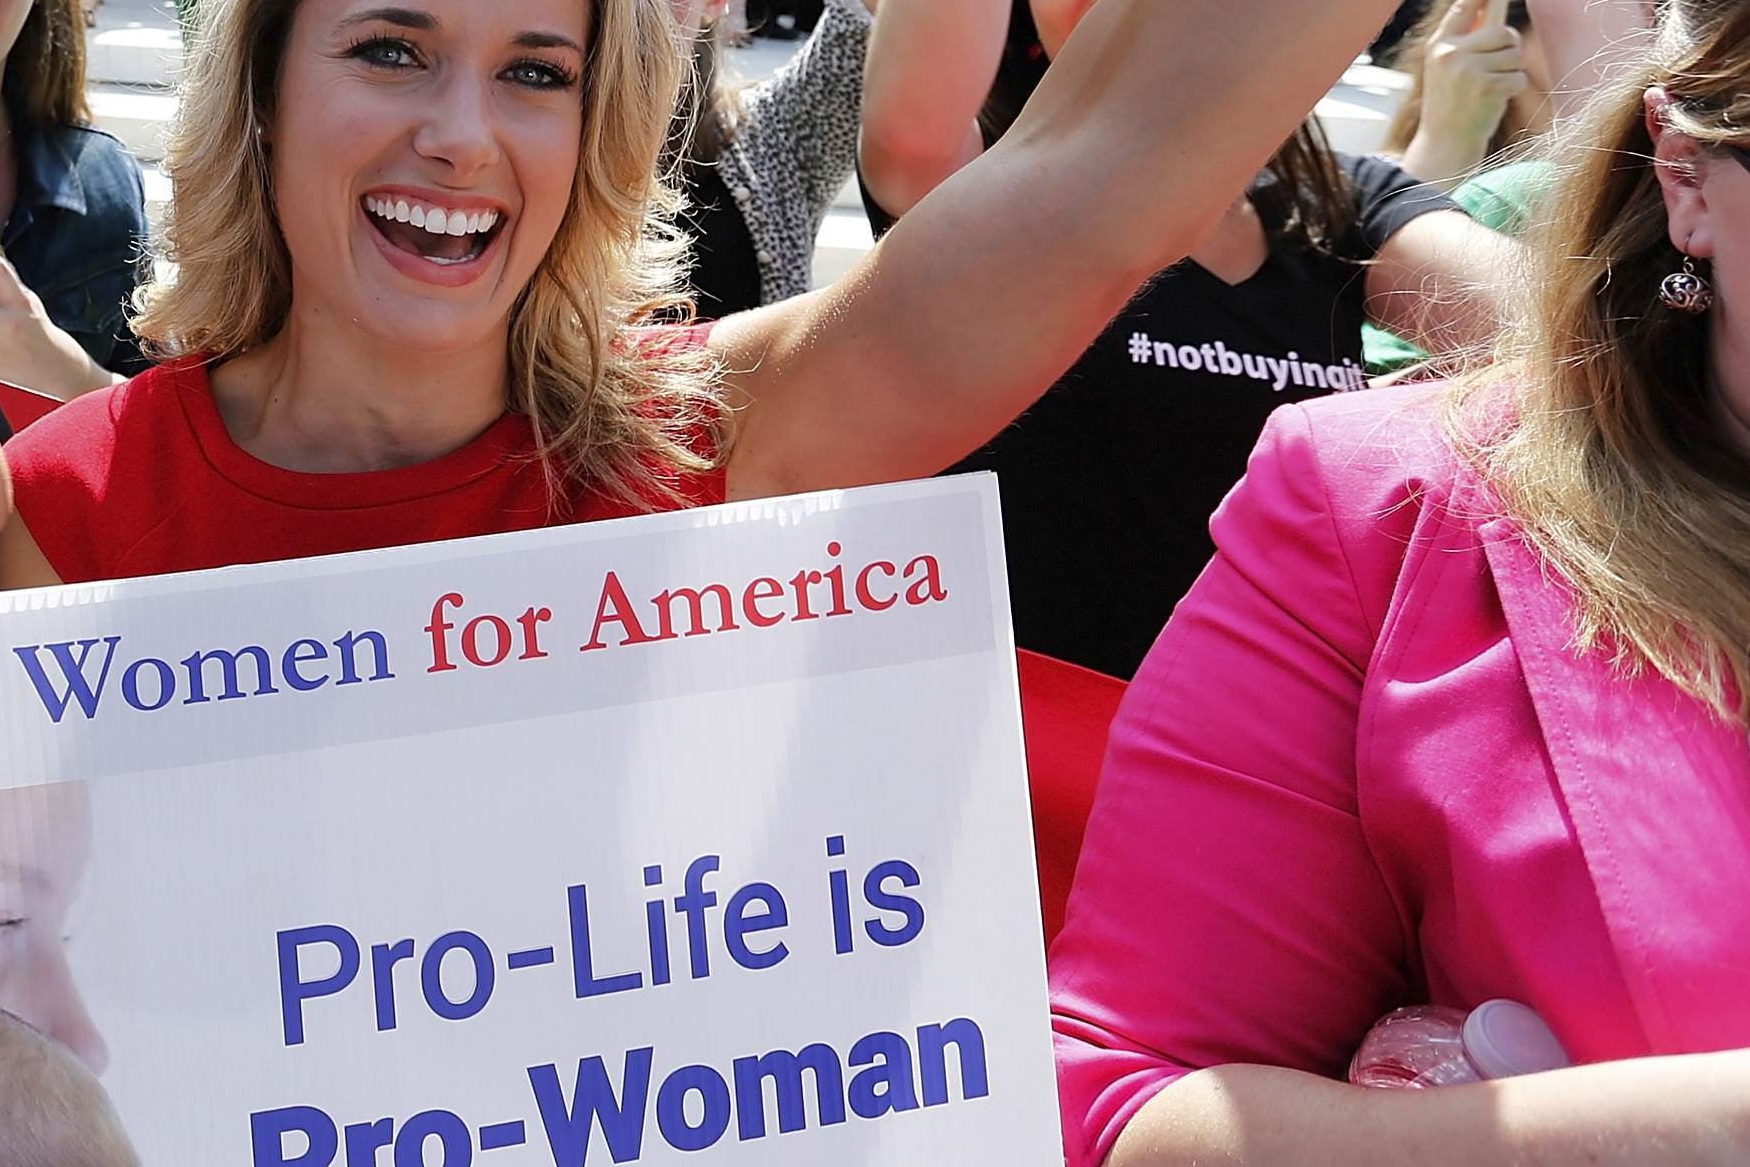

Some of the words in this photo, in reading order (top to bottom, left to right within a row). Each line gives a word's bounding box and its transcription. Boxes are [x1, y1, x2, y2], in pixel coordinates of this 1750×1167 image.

[13, 629, 395, 725] Women
[425, 592, 552, 673] for
[579, 541, 949, 653] America
[275, 854, 790, 1046] Pro-Life
[825, 835, 926, 956] is
